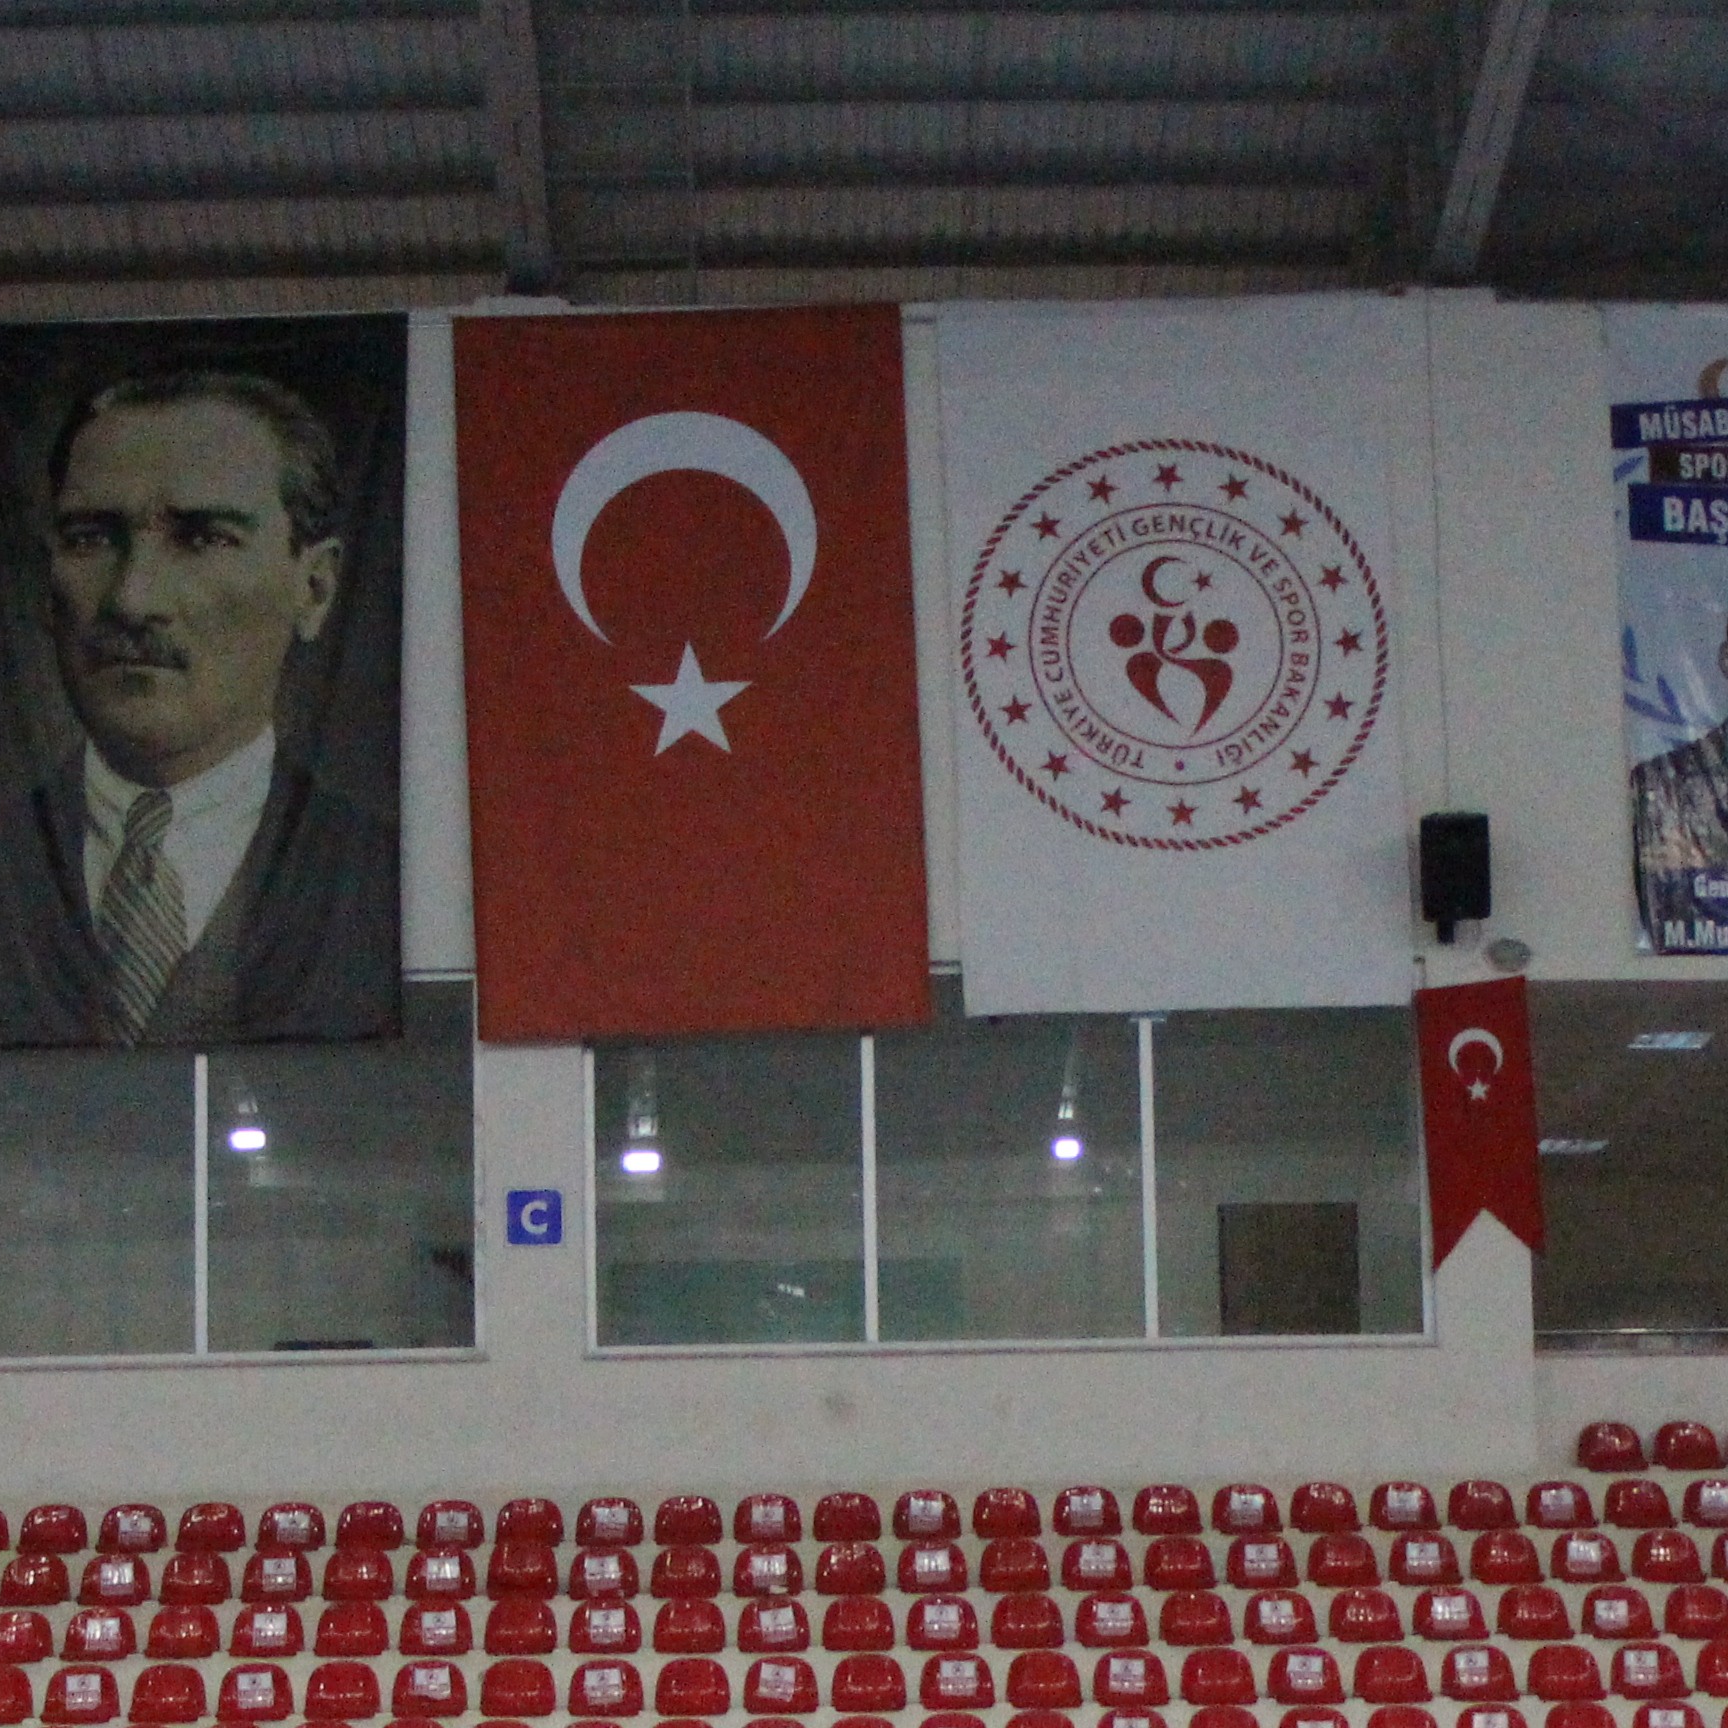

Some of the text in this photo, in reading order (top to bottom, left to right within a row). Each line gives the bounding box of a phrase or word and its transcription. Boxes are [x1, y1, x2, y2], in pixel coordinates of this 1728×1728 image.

[1040, 513, 1310, 770] TÜRKİYE CUMHURİYETİ GENÇLİK VE SPOR BAKANLIĞI
[520, 1200, 549, 1235] C
